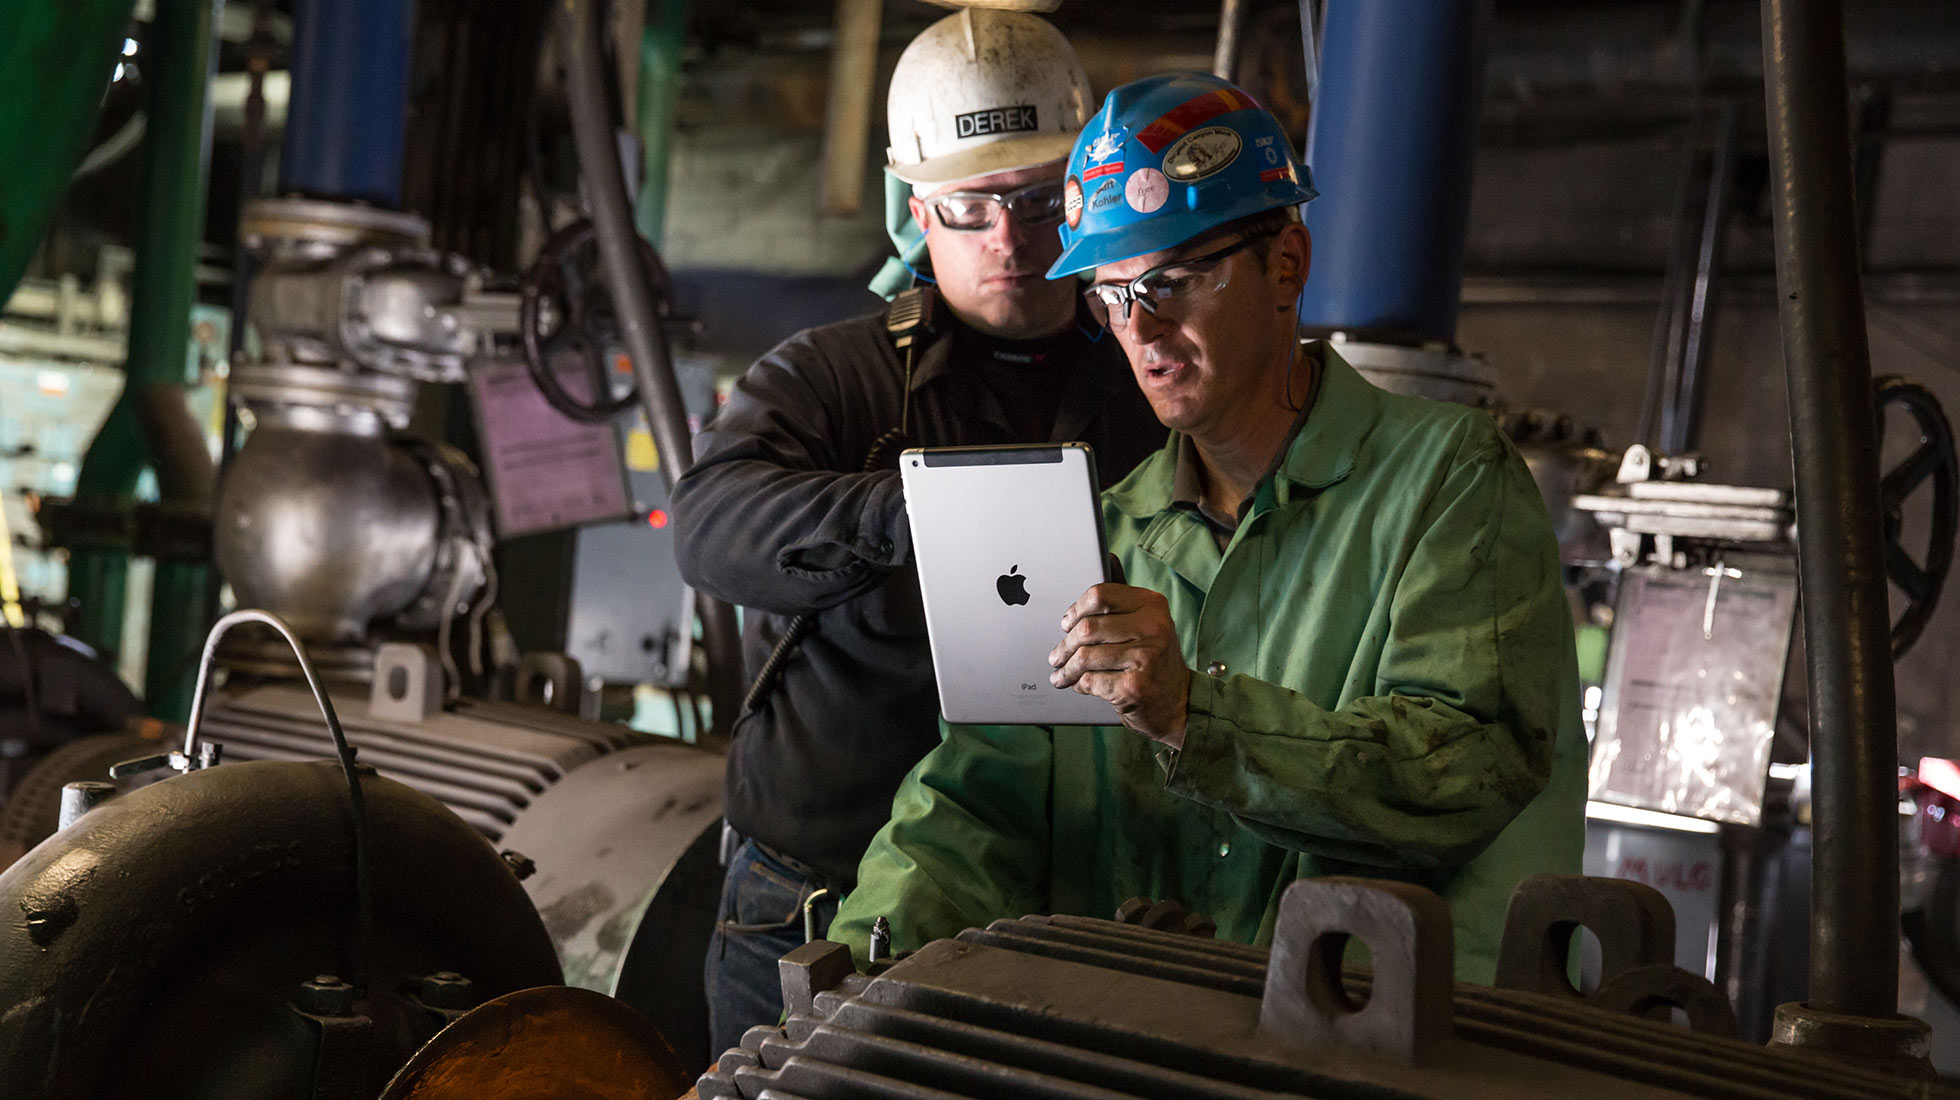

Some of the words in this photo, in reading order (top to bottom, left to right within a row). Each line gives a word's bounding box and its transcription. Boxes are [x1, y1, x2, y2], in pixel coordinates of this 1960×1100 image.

[958, 108, 1035, 137] DEREK
[1092, 193, 1122, 209] Kohler
[1021, 683, 1037, 691] iPad
